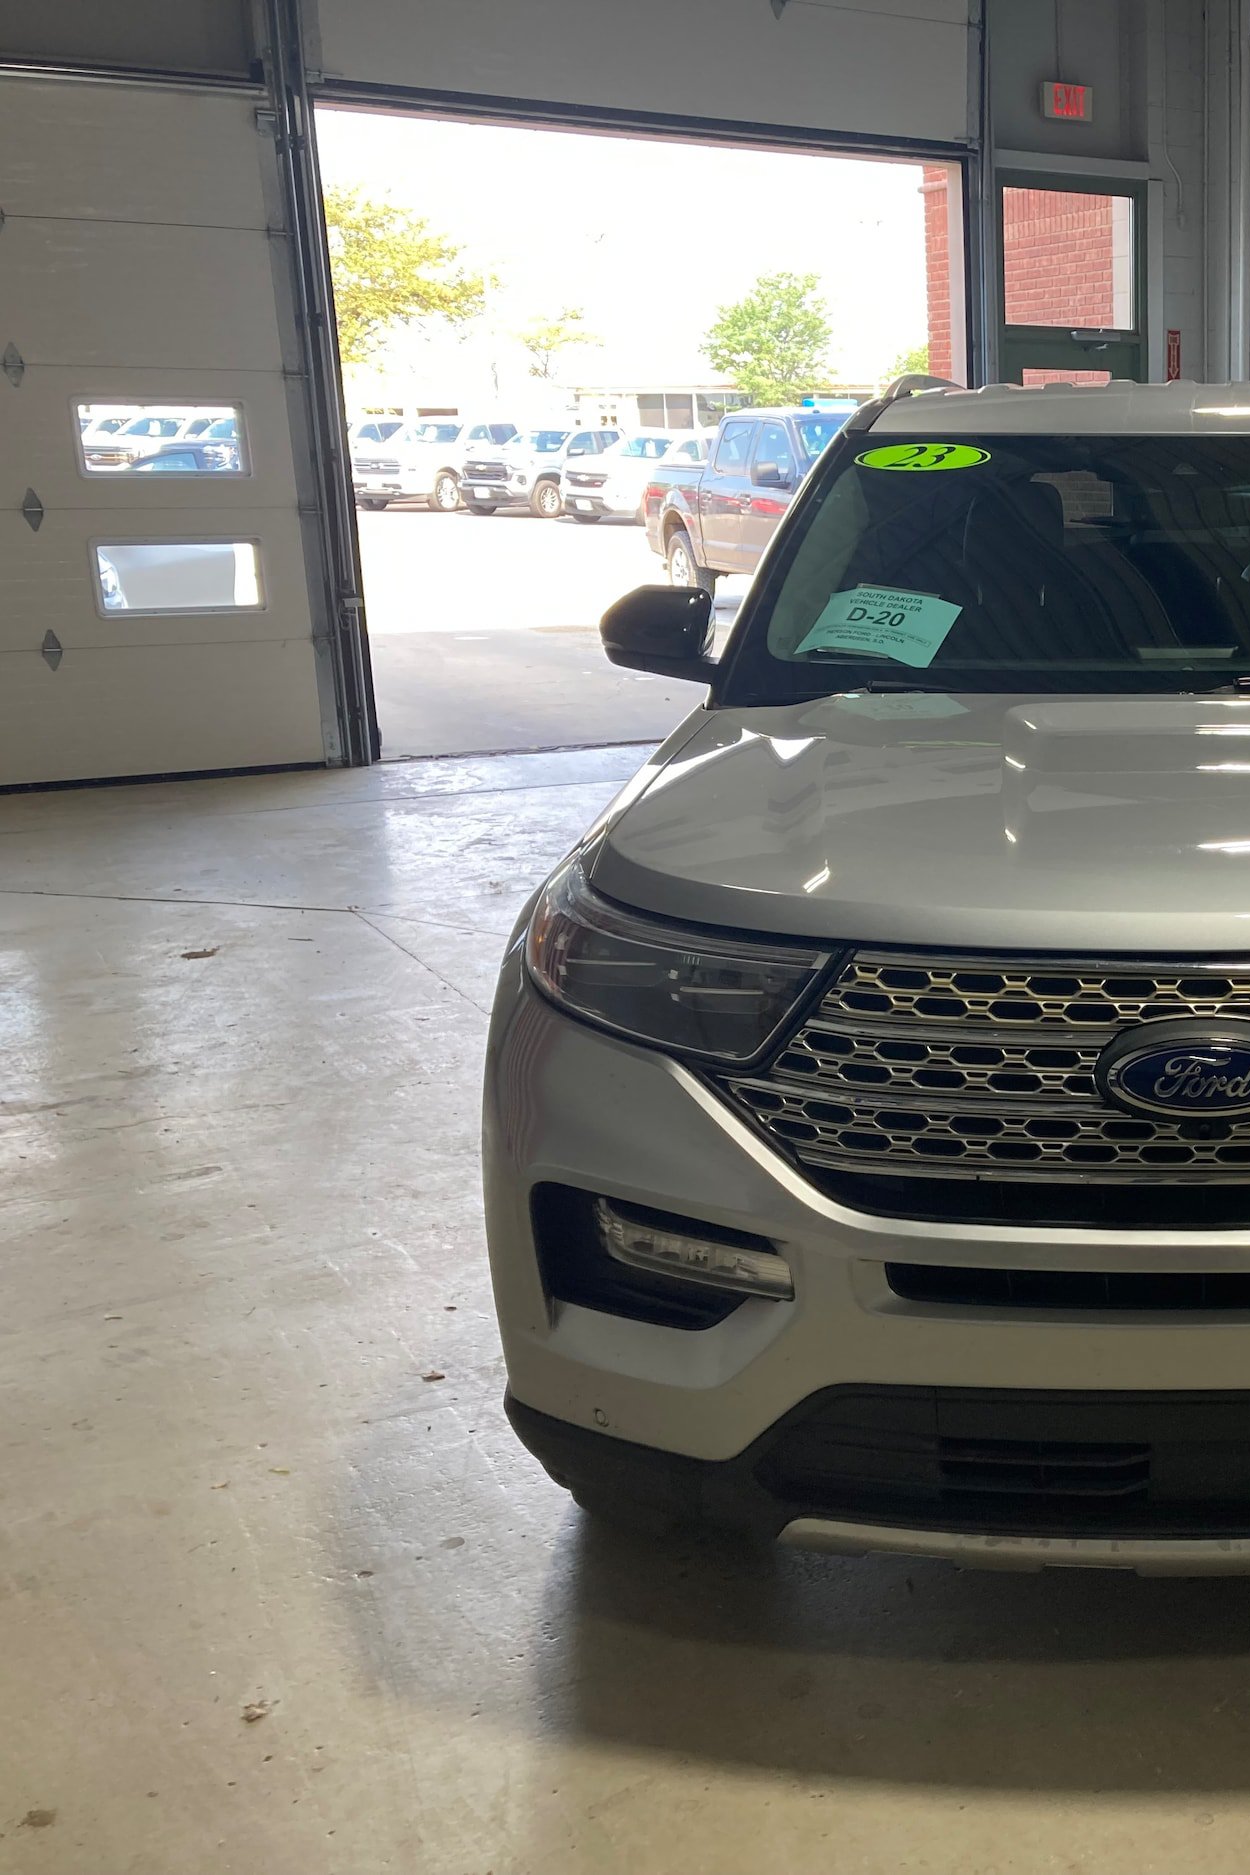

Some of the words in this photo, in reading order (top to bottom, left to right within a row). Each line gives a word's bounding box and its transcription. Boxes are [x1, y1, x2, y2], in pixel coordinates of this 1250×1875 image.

[1053, 84, 1085, 117] EXIT
[887, 446, 956, 467] 23
[849, 598, 886, 608] VEHICLE
[886, 602, 922, 613] DEALER
[857, 591, 886, 600] SOUTH
[887, 594, 923, 605] DAKOTA
[846, 606, 906, 627] D-20
[875, 633, 905, 644] LINCOLN
